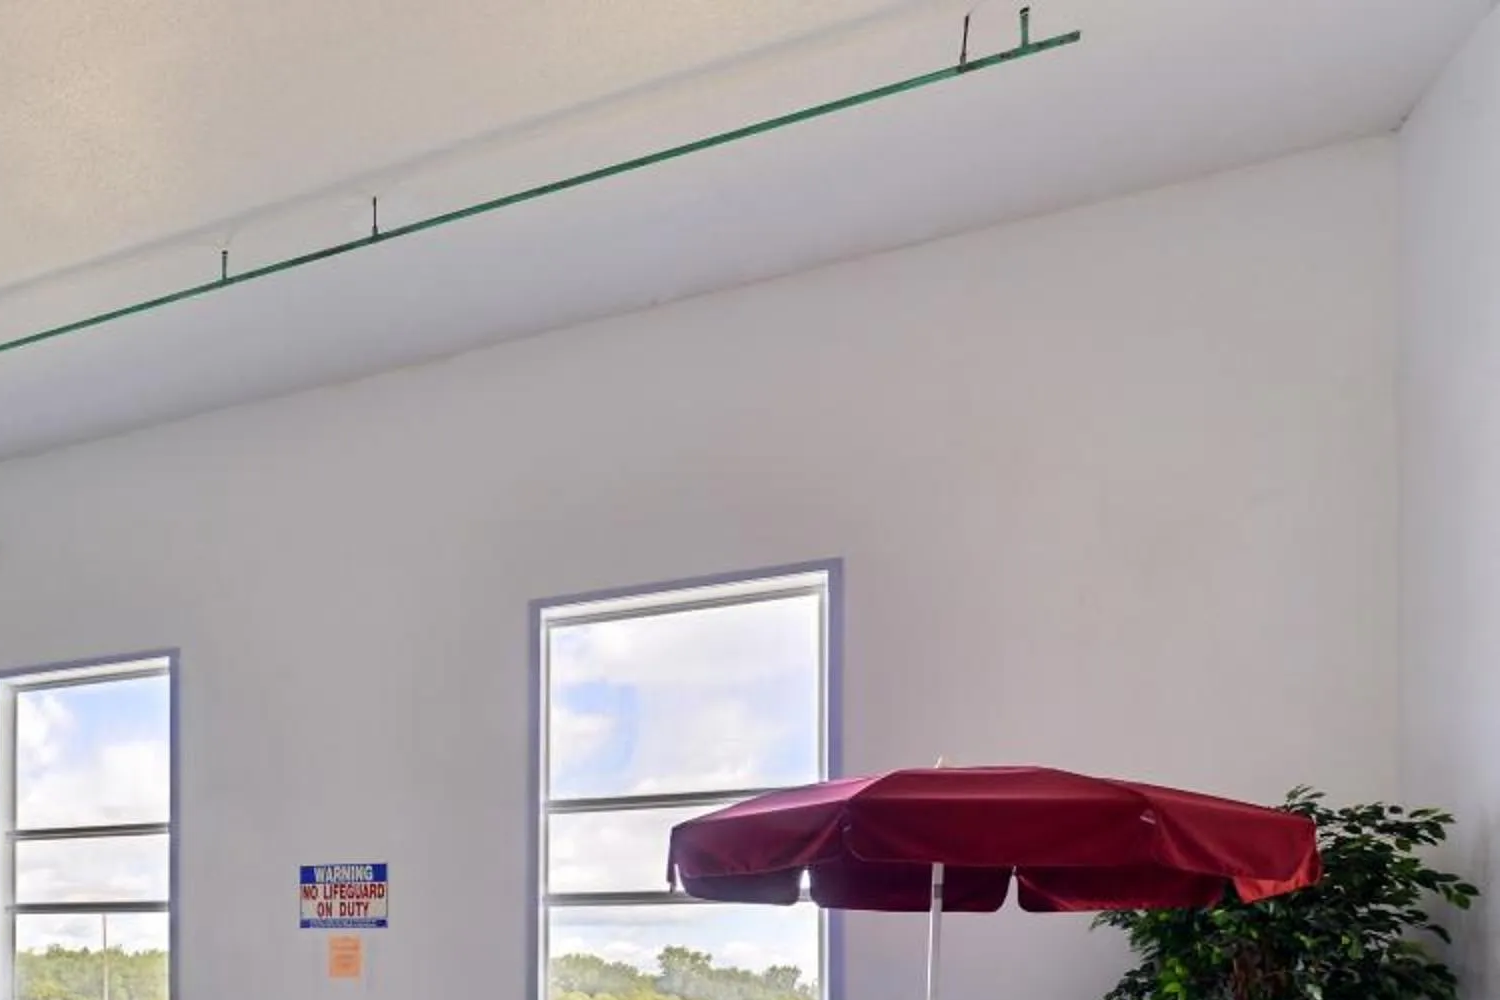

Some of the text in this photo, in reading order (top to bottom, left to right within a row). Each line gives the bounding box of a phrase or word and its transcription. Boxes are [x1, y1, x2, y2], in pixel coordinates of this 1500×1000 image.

[314, 864, 373, 882] WARNING
[303, 883, 385, 900] NO LIFEGUARD
[317, 901, 369, 917] ON DUTY
